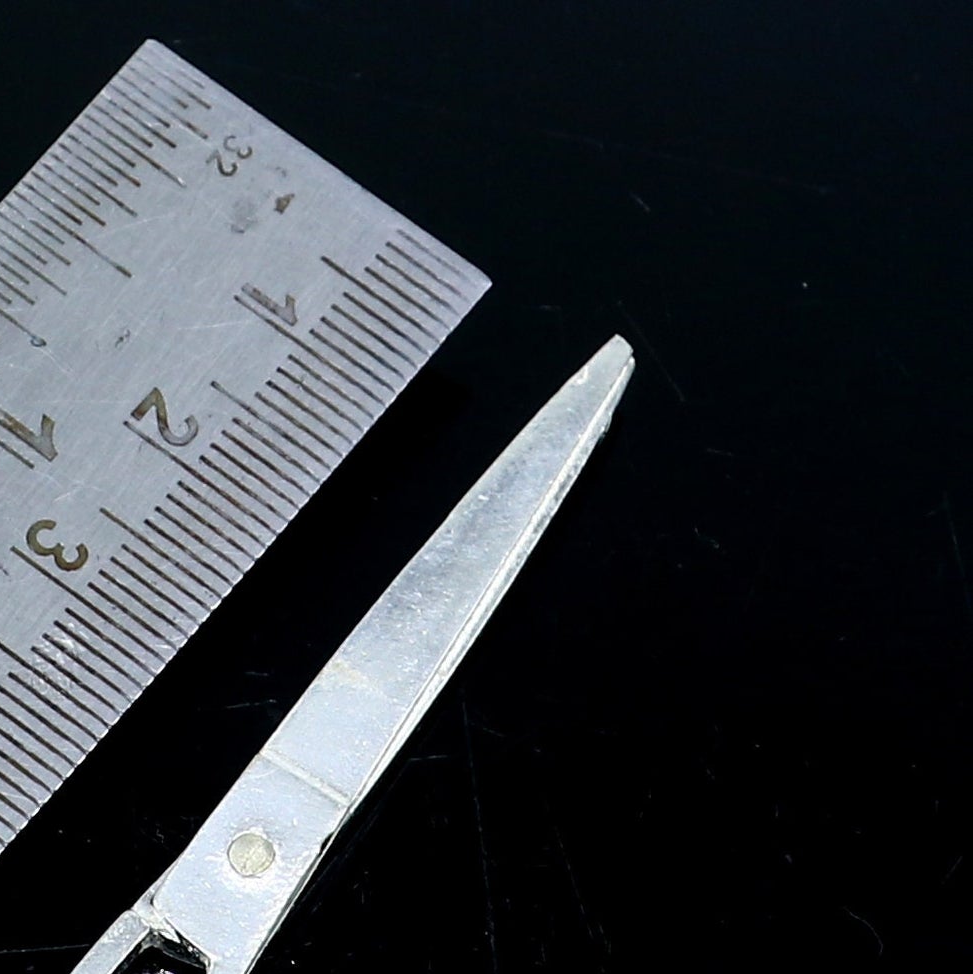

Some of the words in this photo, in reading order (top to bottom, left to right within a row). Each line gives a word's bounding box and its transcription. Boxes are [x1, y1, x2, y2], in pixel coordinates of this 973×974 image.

[207, 135, 252, 177] 32
[240, 282, 298, 326] 1
[131, 387, 199, 447] 2
[26, 520, 89, 571] 3
